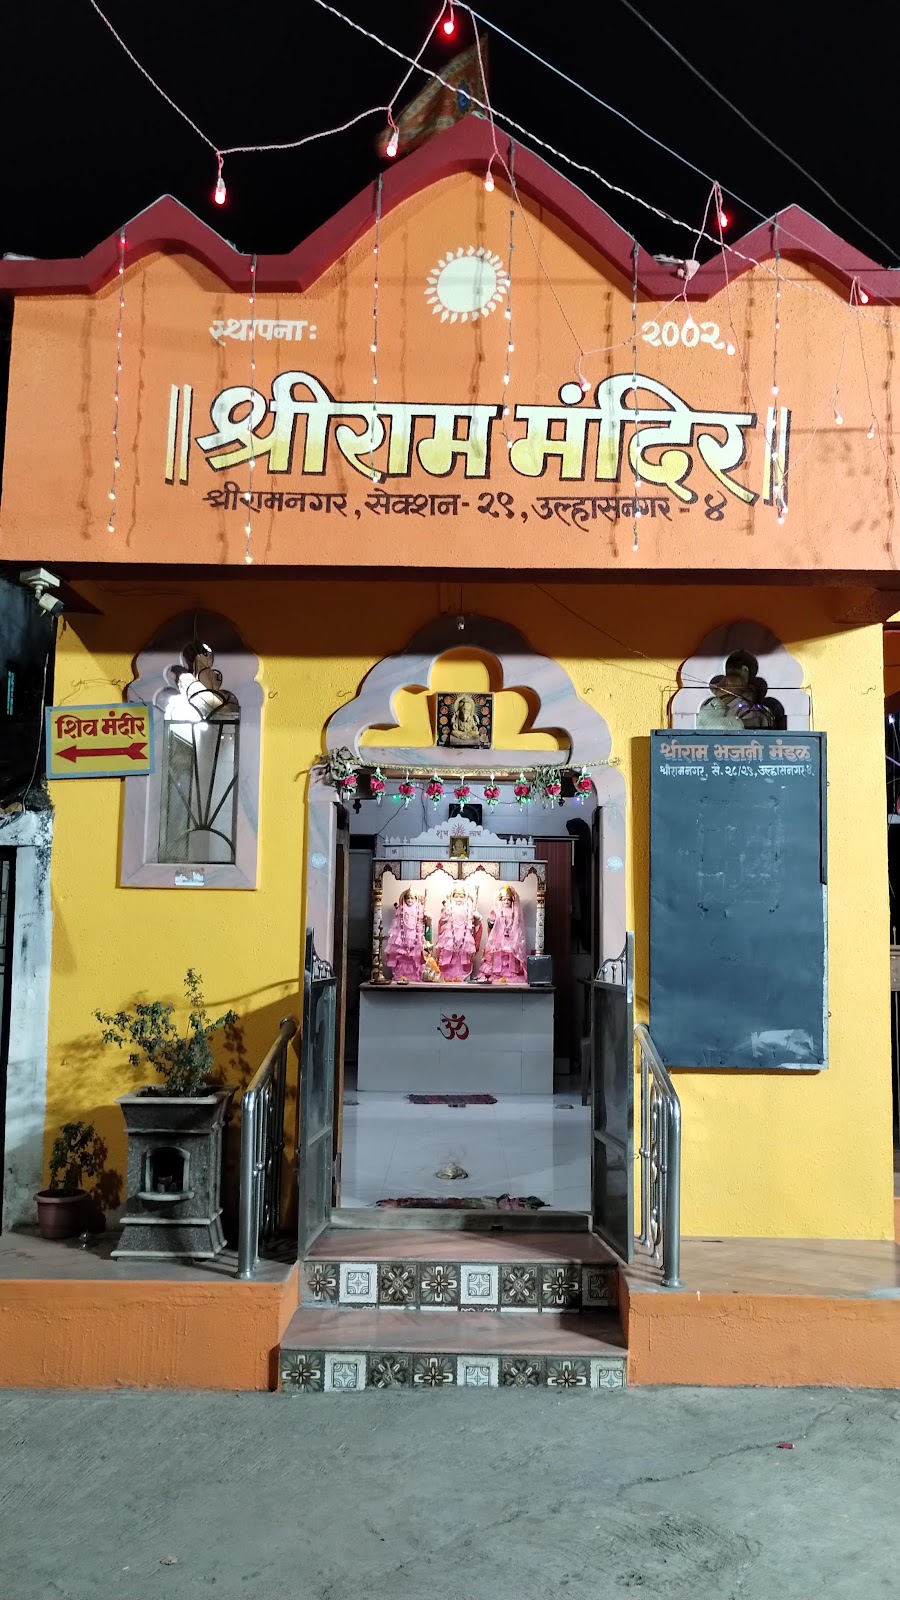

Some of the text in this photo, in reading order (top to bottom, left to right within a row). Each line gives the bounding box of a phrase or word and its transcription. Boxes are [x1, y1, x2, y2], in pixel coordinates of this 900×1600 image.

[208, 318, 318, 347] स्थापना:
[194, 370, 503, 484] श्रीराम
[509, 372, 760, 506] मंदिर
[55, 710, 147, 740] शिव मंदीर
[660, 739, 709, 763] श्रीराम
[713, 739, 765, 763] भजनी
[436, 830, 482, 840] शुभ लाभ
